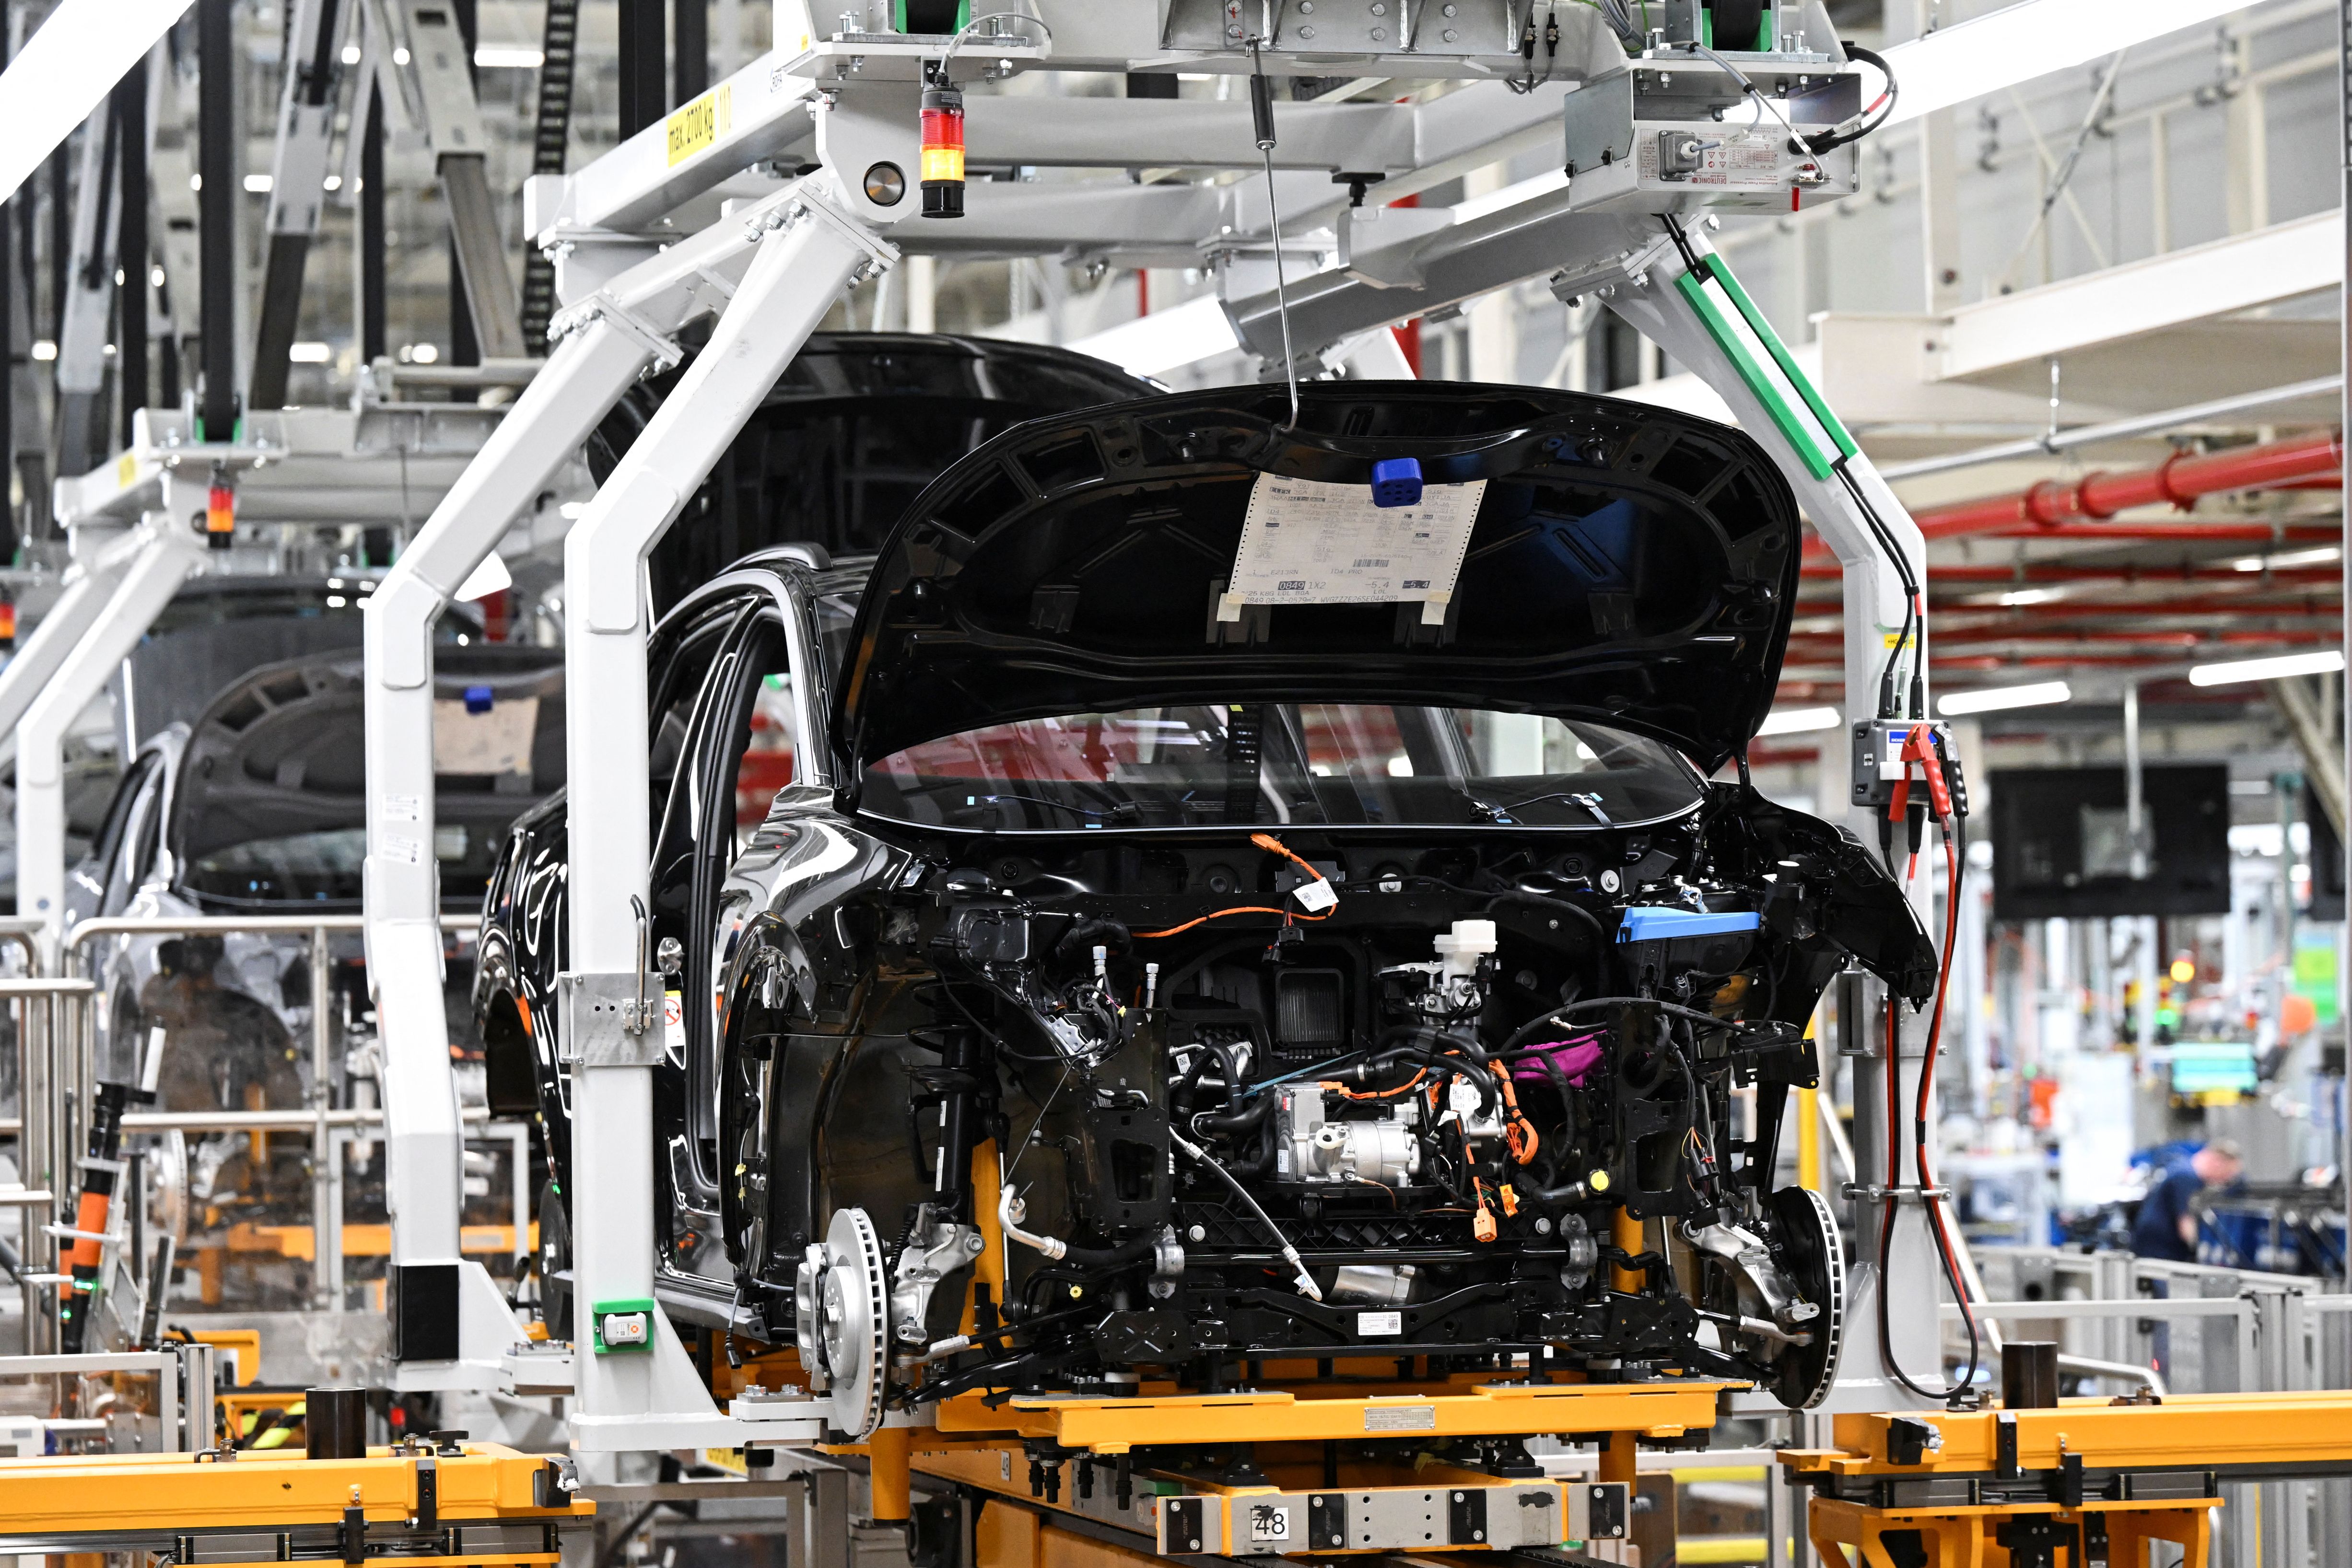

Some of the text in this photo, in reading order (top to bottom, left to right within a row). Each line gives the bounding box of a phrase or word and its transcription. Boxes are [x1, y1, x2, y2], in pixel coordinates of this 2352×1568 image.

[669, 101, 713, 154] max. 2700 kg
[1255, 1513, 1285, 1534] 48
